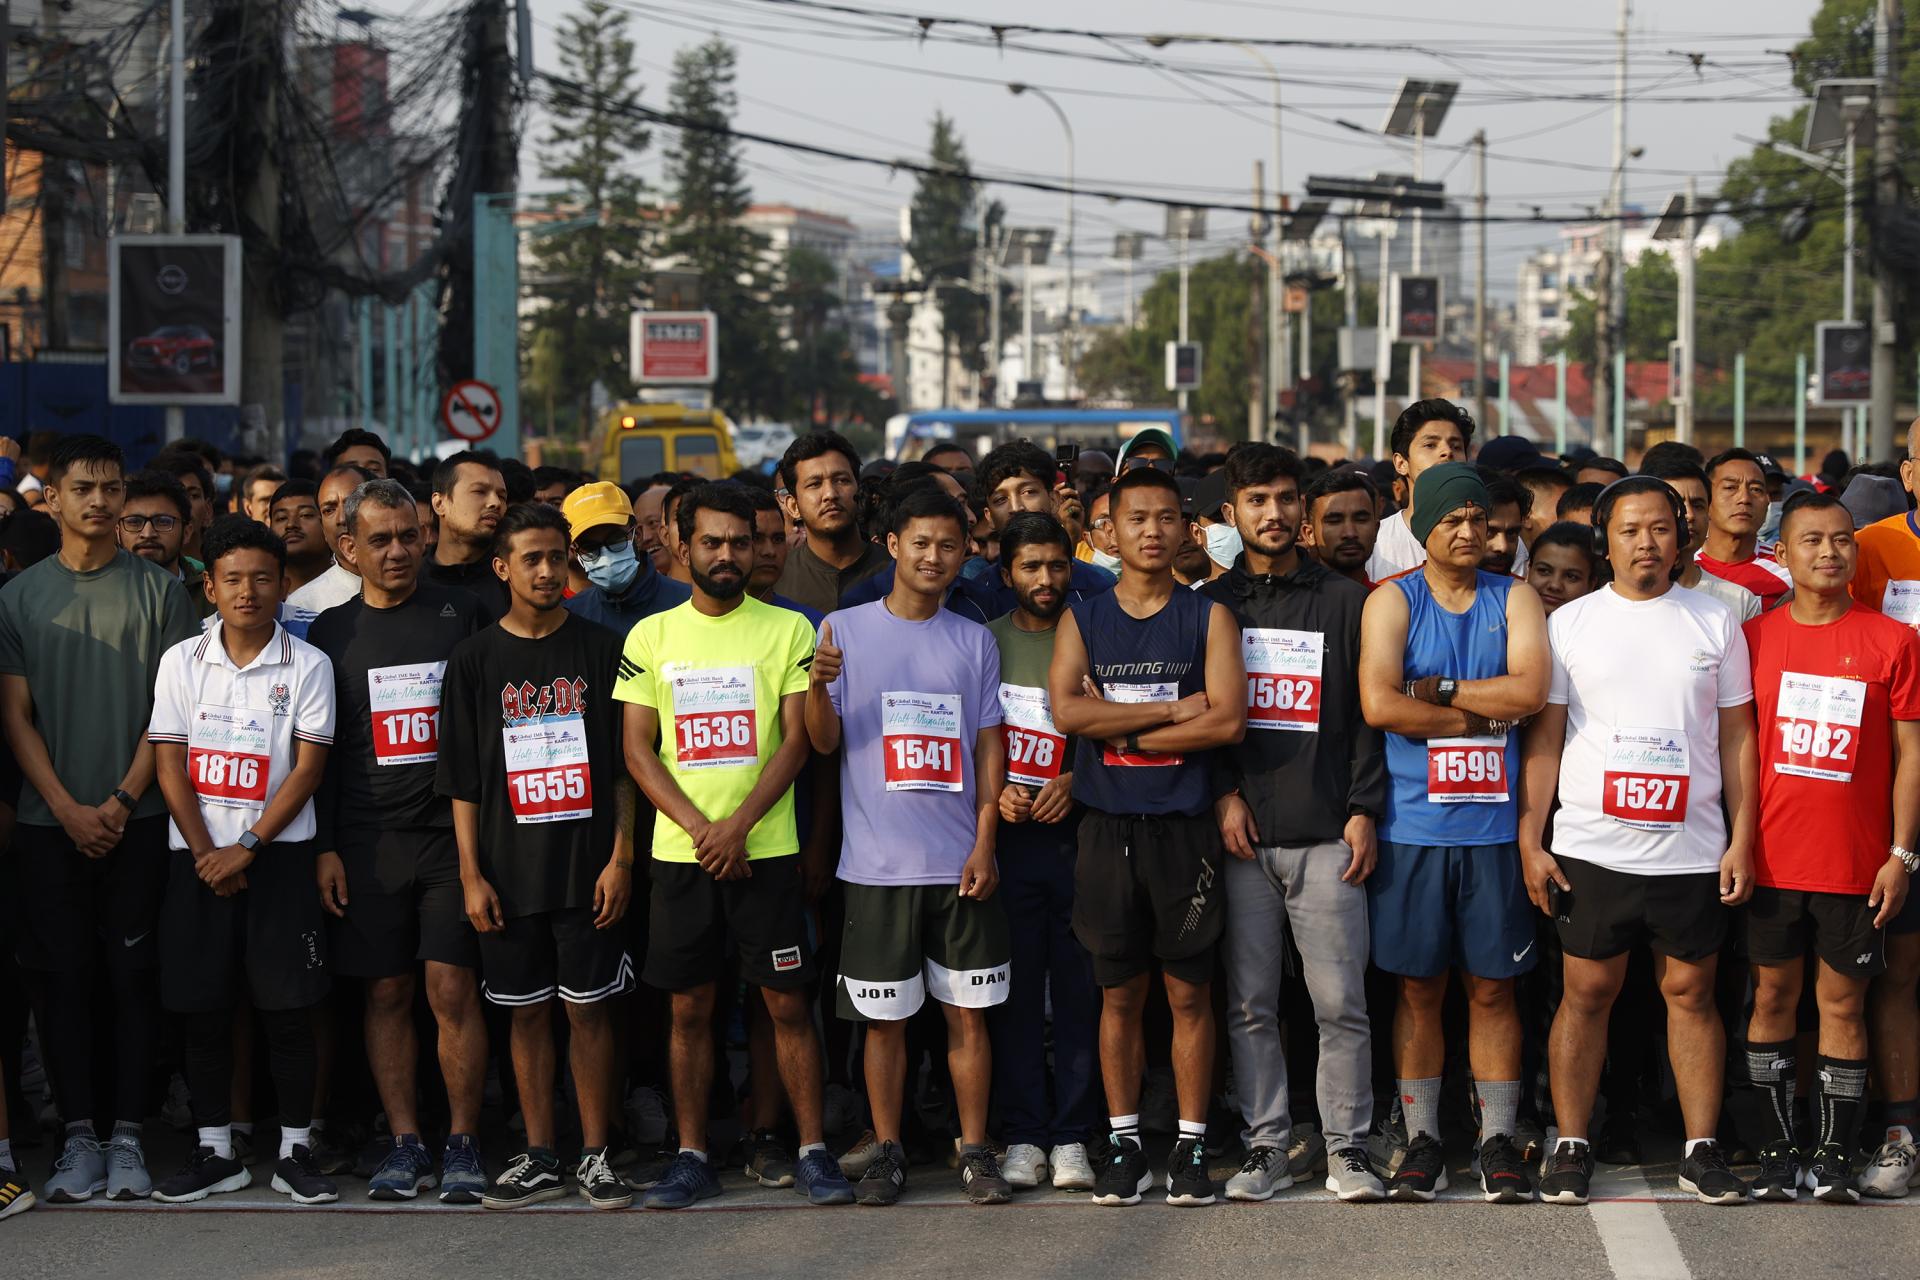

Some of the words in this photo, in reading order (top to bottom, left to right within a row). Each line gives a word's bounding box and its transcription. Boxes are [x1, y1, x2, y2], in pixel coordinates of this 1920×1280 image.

[1247, 677, 1314, 711] 1582
[1831, 695, 1856, 704] KANTIPUR
[241, 726, 265, 734] KANTIPUR
[382, 711, 440, 745] 1761
[554, 737, 579, 745] KANTIPUR
[679, 714, 751, 750] 1536
[1779, 721, 1852, 761] 1982
[195, 753, 259, 789] 1816
[891, 738, 952, 771] 1541
[1432, 750, 1501, 782] 1599
[511, 767, 585, 805] 1555
[1612, 776, 1681, 811] 1527
[307, 936, 318, 964] STRIX
[857, 987, 897, 999] JOR
[971, 970, 1006, 986] DAN
